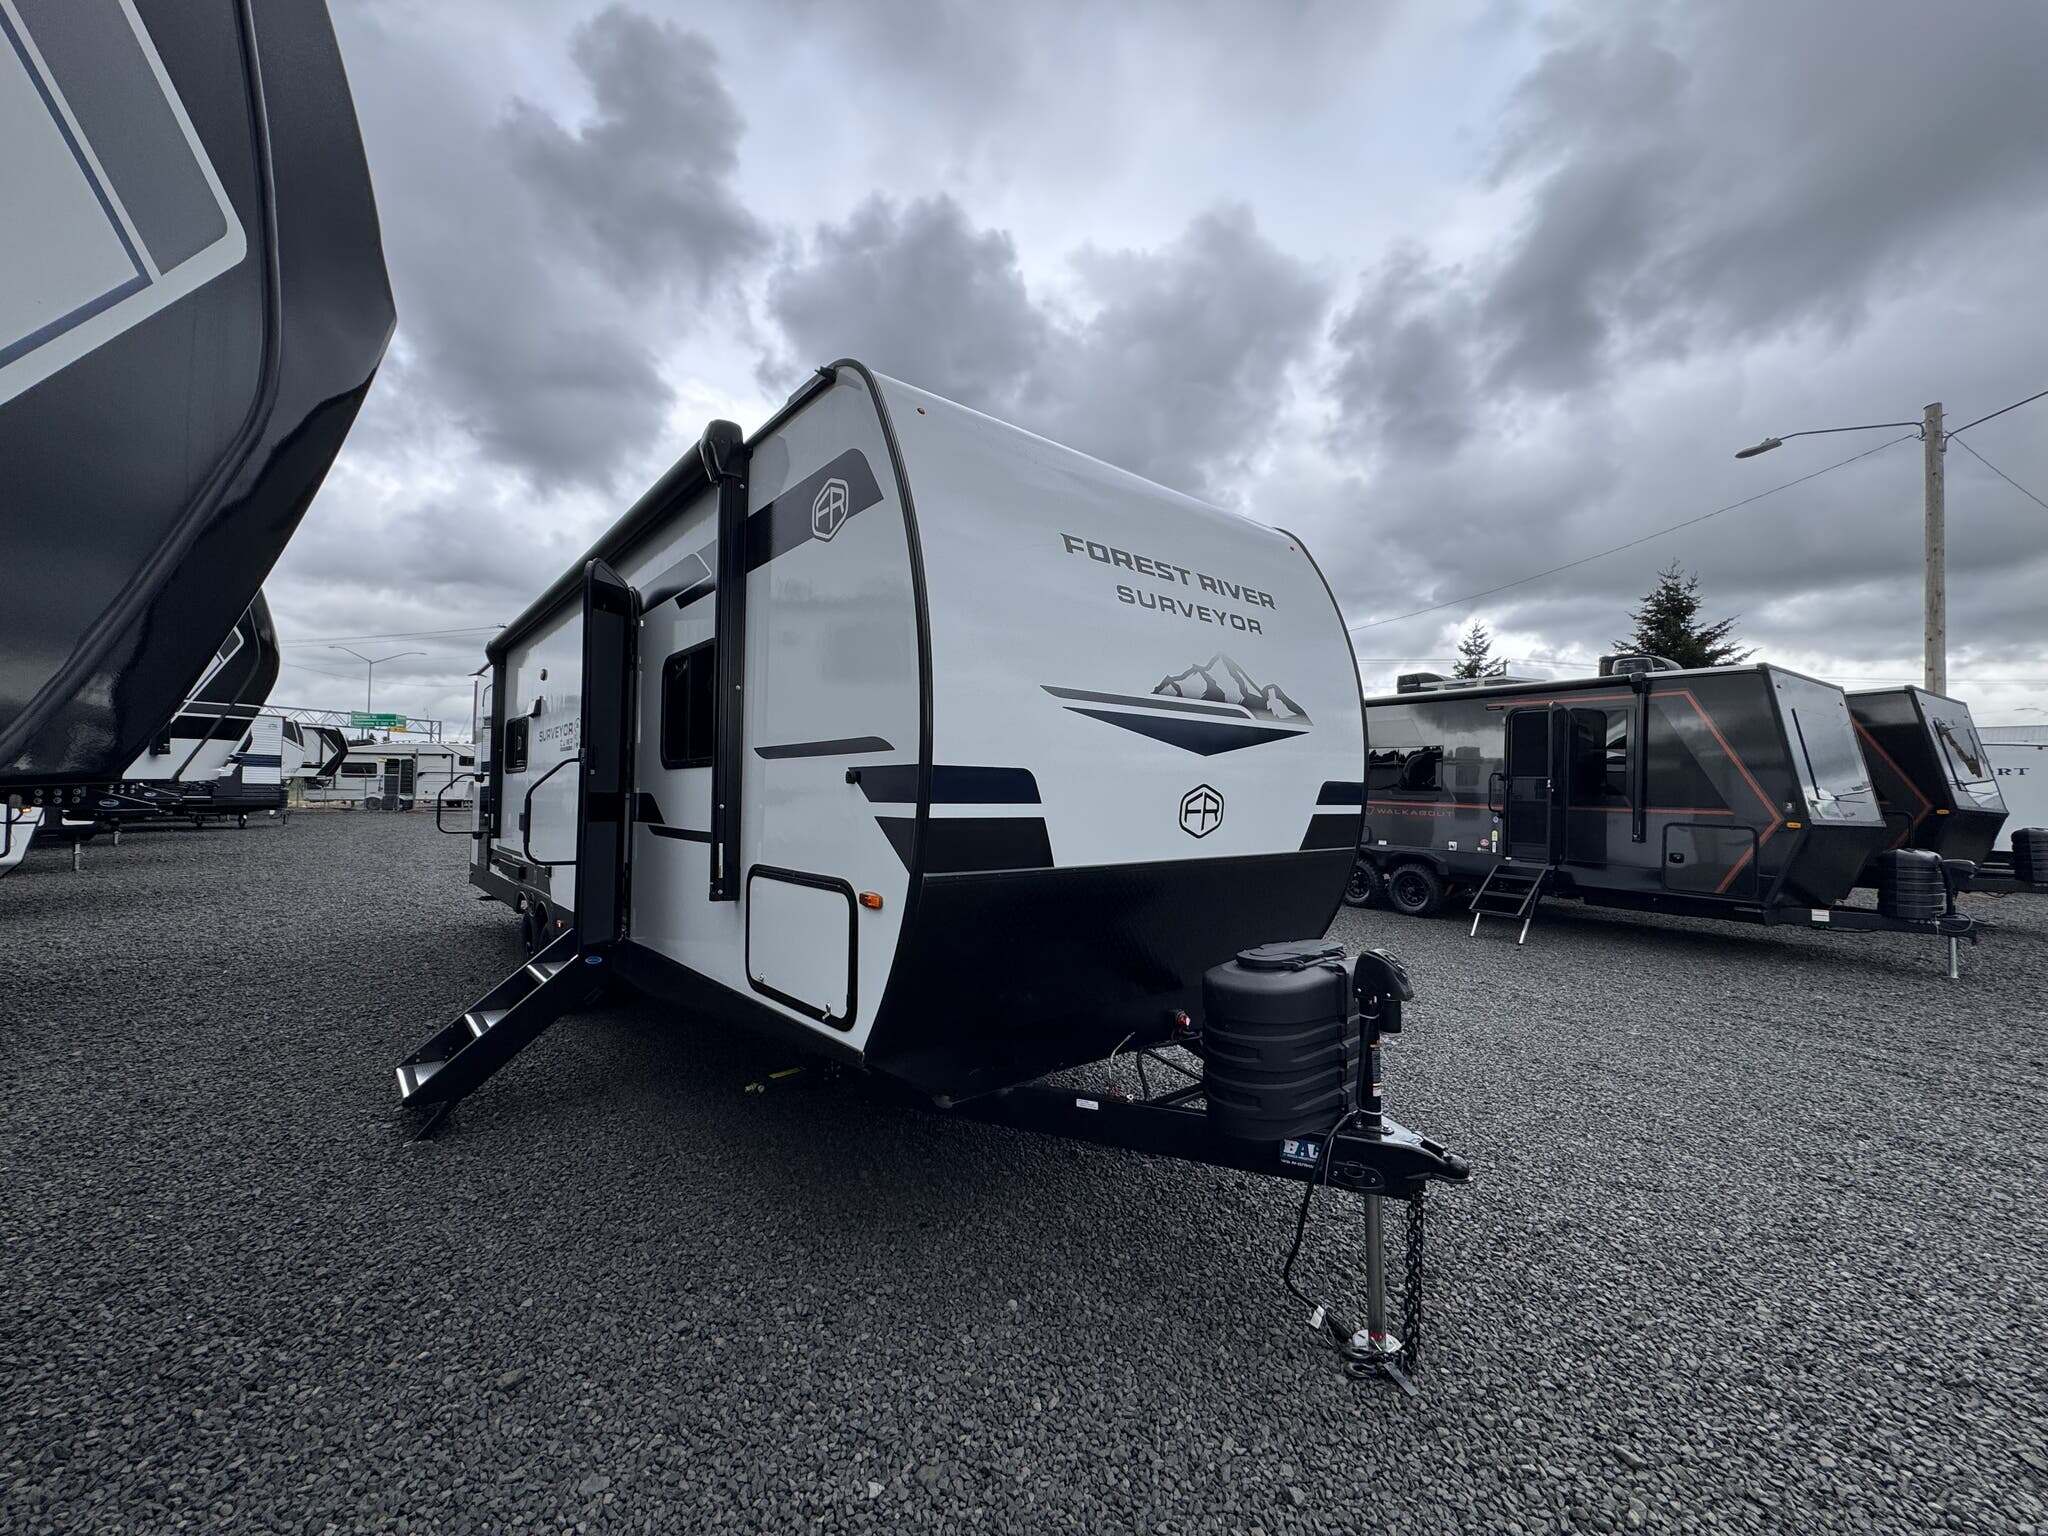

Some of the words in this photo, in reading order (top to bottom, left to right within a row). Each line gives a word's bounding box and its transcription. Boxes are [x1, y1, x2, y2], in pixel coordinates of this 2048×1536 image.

[1060, 532, 1191, 586] FOREST
[1196, 573, 1278, 611] RIVER
[1116, 584, 1264, 636] SURVEYOR
[538, 722, 574, 742] SURVEYOR
[1376, 807, 1454, 817] WALKABOUT
